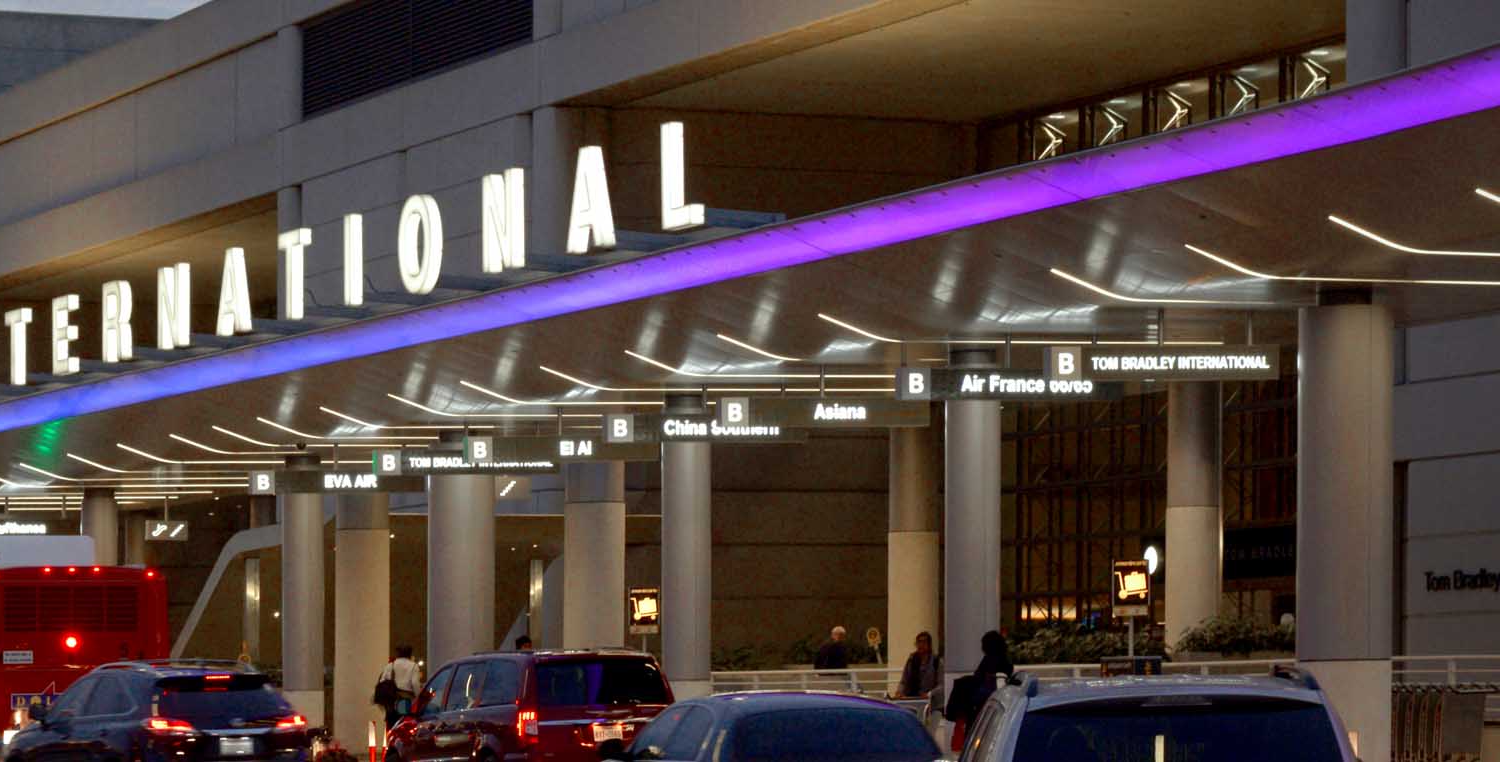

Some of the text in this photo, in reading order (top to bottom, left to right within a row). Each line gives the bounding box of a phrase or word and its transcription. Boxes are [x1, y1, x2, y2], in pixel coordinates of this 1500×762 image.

[1058, 352, 1270, 375] B TOM BRADLEY INTERNATIONAL
[908, 373, 925, 394] B
[961, 374, 985, 393] Air
[989, 375, 1046, 393] France
[727, 402, 866, 422] B Asiana
[614, 419, 628, 437] B
[664, 419, 707, 436] China
[473, 441, 488, 459] B
[382, 454, 396, 471] B
[409, 457, 432, 468] TOM
[256, 474, 378, 490] B EVA AIR
